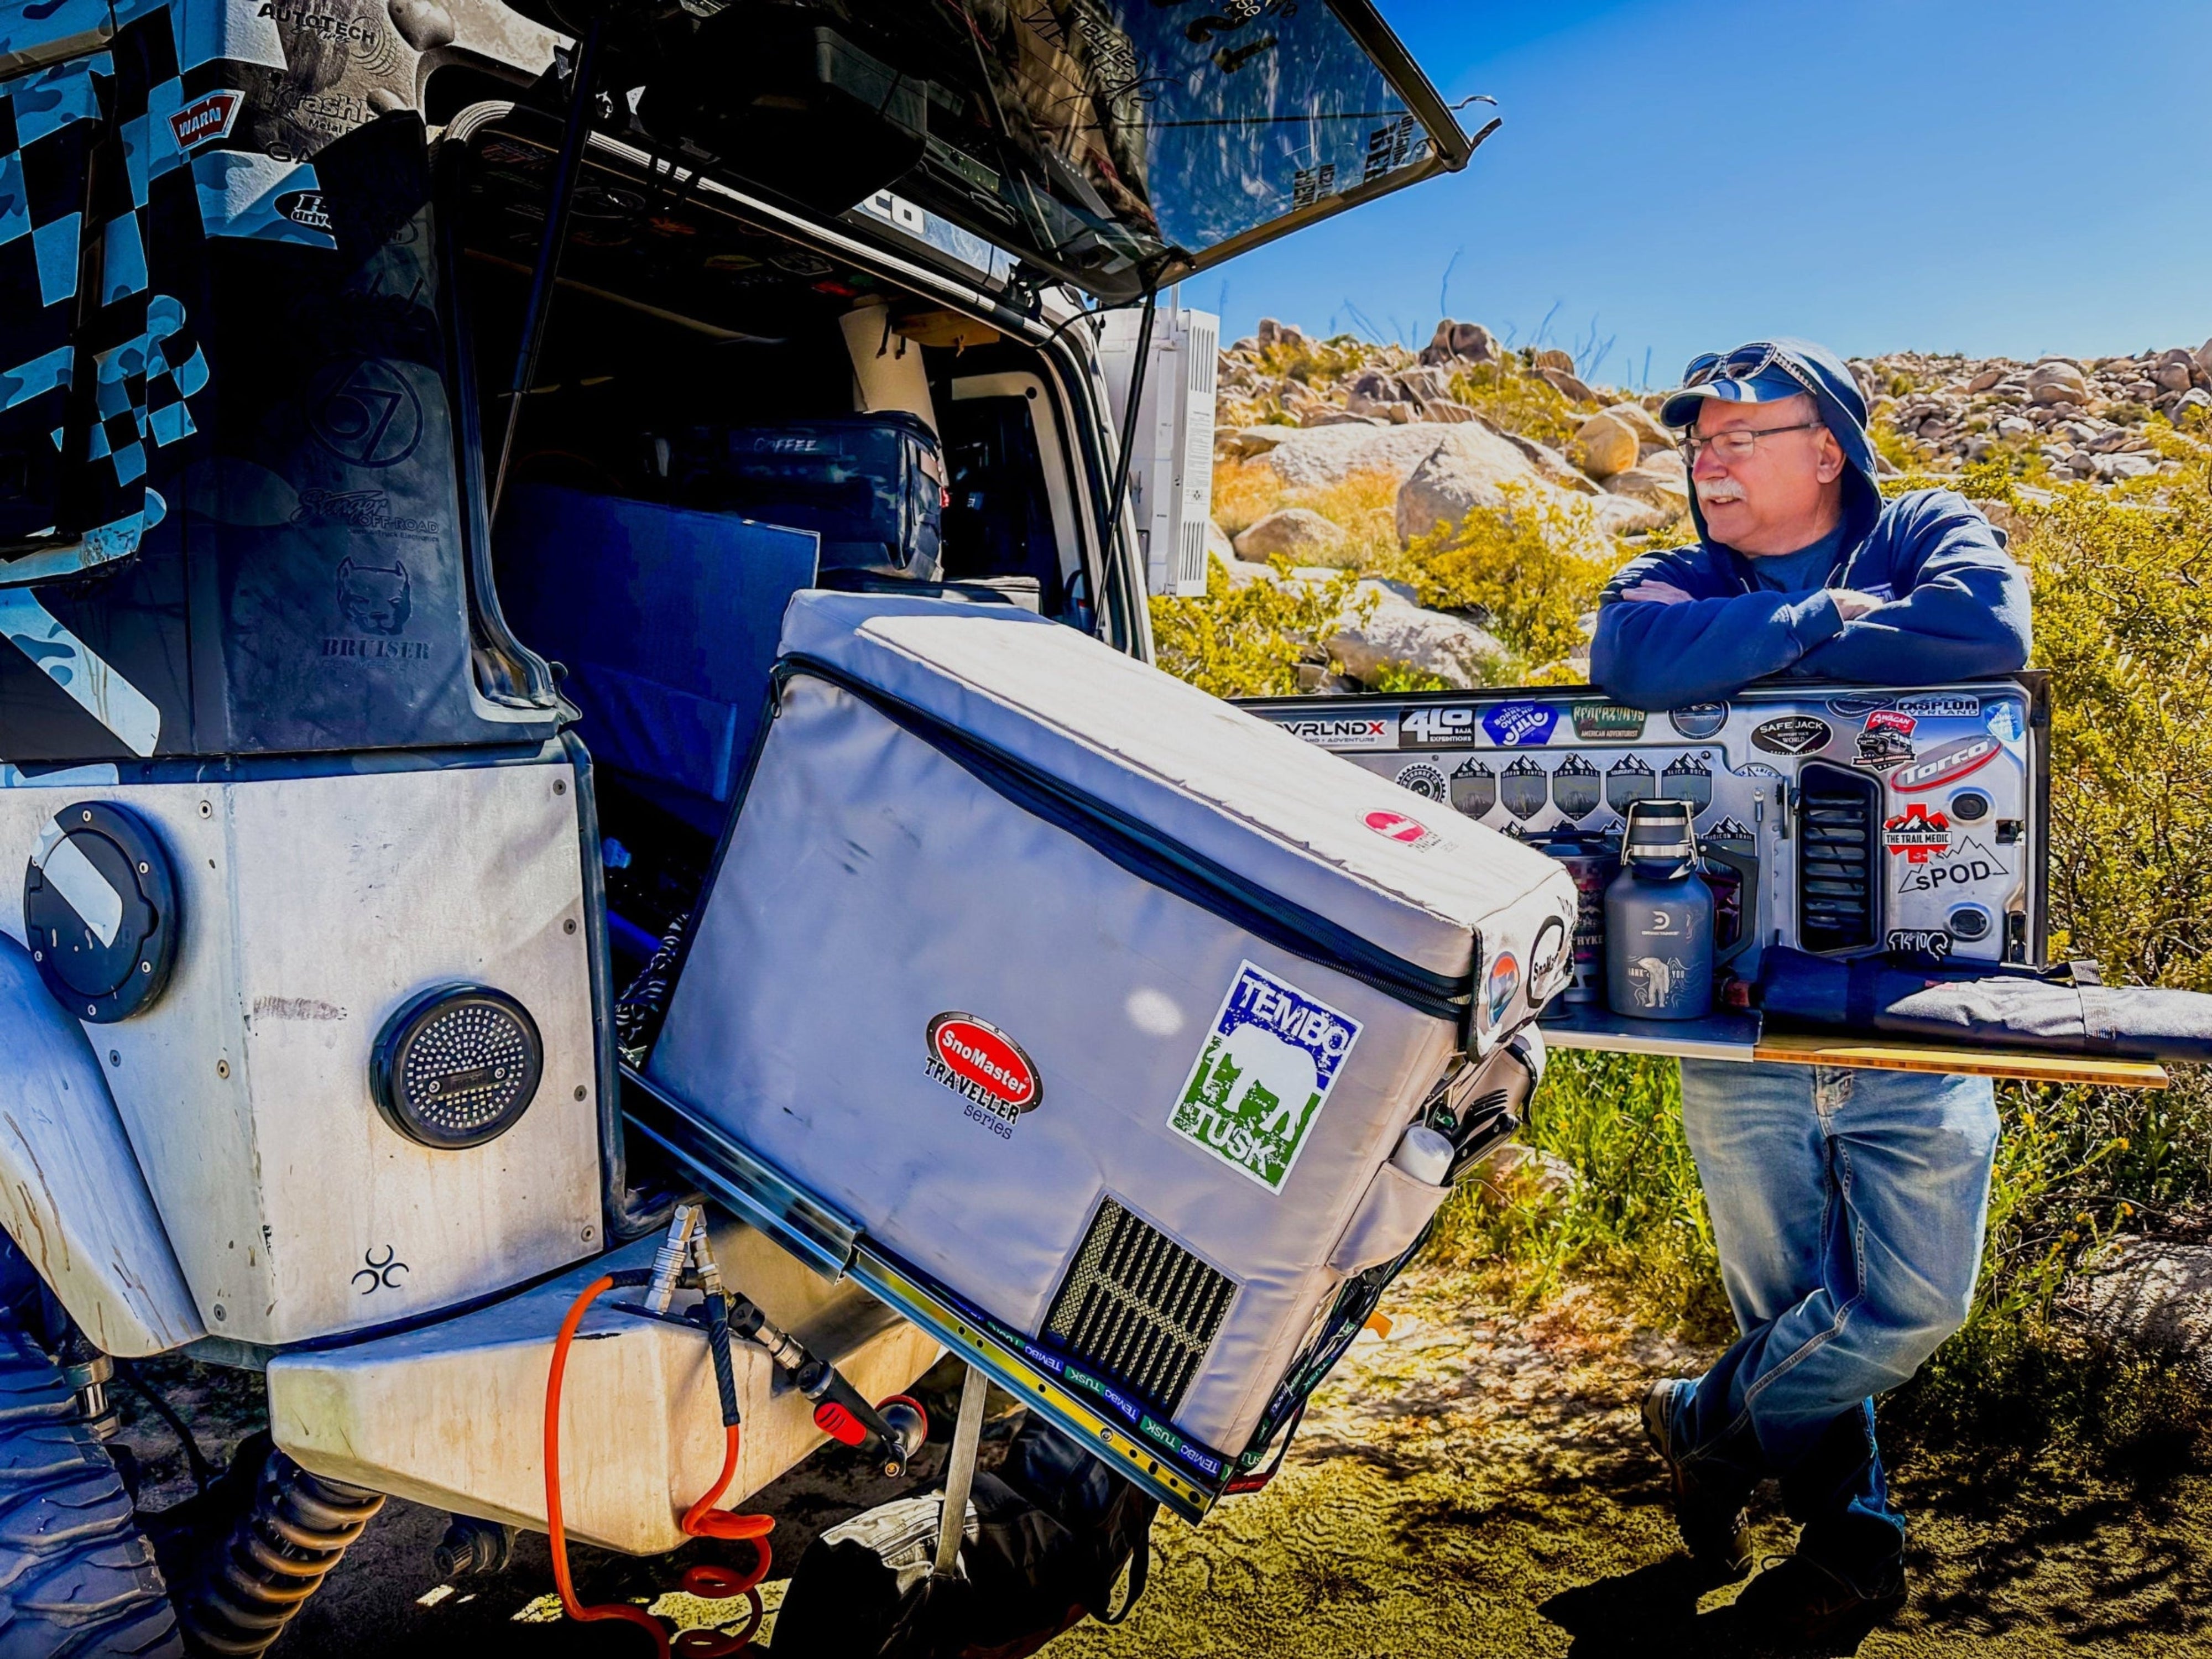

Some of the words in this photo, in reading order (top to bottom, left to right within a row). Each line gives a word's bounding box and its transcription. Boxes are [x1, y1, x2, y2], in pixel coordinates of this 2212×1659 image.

[257, 3, 376, 45] AUTOTECH
[179, 107, 221, 138] WARN
[308, 118, 343, 133] Metal
[359, 514, 439, 534] OFF-ROAD
[319, 639, 430, 660] BRUISER
[1501, 708, 1533, 728] OVRLND
[1760, 721, 1793, 733] SAFE
[1794, 721, 1823, 730] JACK
[1902, 742, 1988, 784] Torco
[1886, 834, 1900, 843] THE
[1901, 834, 1924, 843] TRAIL
[1924, 833, 1949, 843] MEDIC
[1916, 860, 1990, 890] sPOD
[1672, 971, 1686, 979] YOU
[1237, 974, 1349, 1055] TEMBO
[942, 1030, 1027, 1095] SnoMaster
[925, 1056, 1020, 1125] TRAVELLER
[963, 1104, 1013, 1140] series
[1192, 1099, 1274, 1188] TUSK
[1025, 1345, 1062, 1371] TEMBO
[1070, 1368, 1100, 1392] TUSK
[1104, 1389, 1138, 1421] TEMBO
[1146, 1419, 1176, 1449] TUSK
[1180, 1443, 1218, 1476] TEMBO
